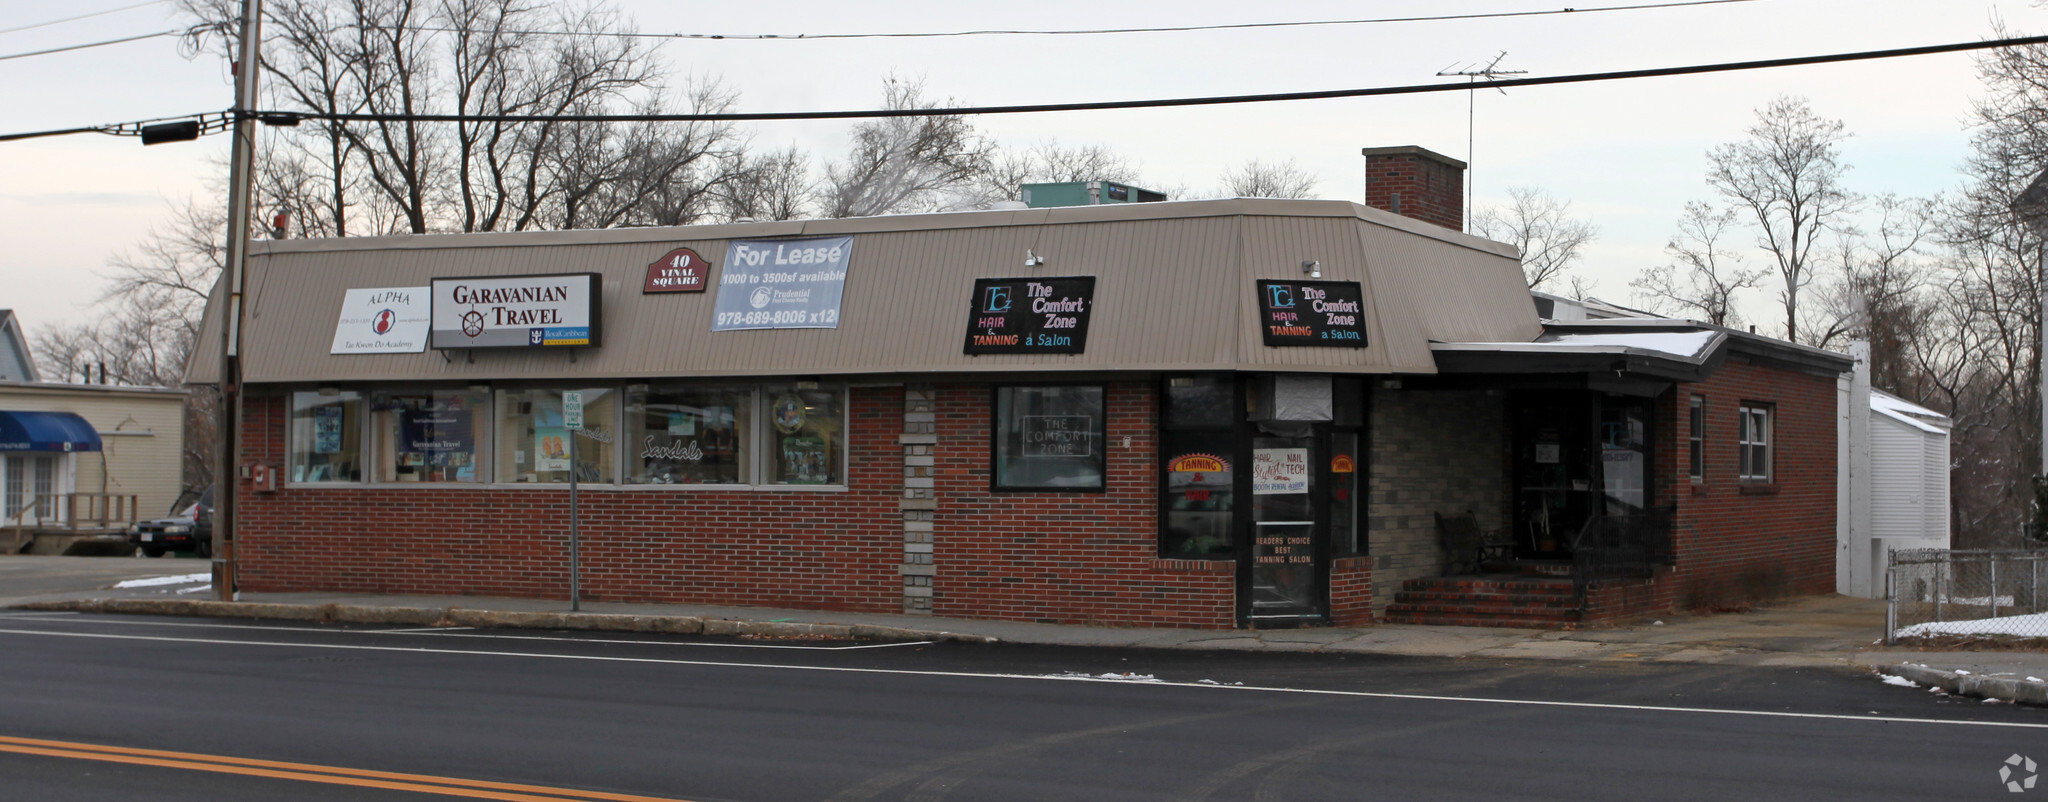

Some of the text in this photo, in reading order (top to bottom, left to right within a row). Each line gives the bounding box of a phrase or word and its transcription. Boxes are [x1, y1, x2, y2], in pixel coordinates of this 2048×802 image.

[670, 254, 690, 268] 40
[733, 244, 841, 266] For Lease
[661, 268, 695, 277] VINAL
[723, 270, 845, 284] 1000 to 3500sf available
[652, 277, 699, 287] SQUARE
[453, 285, 568, 304] GARAVANIAN
[773, 288, 811, 298] Prudential
[1027, 282, 1053, 298] The
[1302, 286, 1327, 300] The
[367, 291, 411, 306] ALPHA
[1032, 297, 1085, 314] Comfort
[1312, 299, 1359, 314] Comfort
[492, 306, 562, 325] TRAVEL
[717, 309, 836, 326] 978-689-8006 x12
[1043, 313, 1077, 329] Zone
[1272, 312, 1299, 321] HAIR
[1326, 312, 1356, 326] Zone
[978, 317, 1005, 328] HAIR
[1270, 326, 1313, 336] TANNING
[1321, 329, 1361, 340] a Salon
[355, 340, 374, 349] Kwon
[374, 340, 384, 348] Do
[384, 339, 413, 350] Academy
[973, 334, 1019, 346] TANNING
[1025, 333, 1072, 347] a Salon
[567, 394, 578, 402] ONE
[565, 403, 580, 411] HOUR
[1042, 418, 1068, 430] THE
[1026, 430, 1089, 443] COMFORT
[443, 440, 461, 449] Travel
[641, 435, 704, 460] Sandals
[1040, 443, 1074, 455] ZONE
[1253, 453, 1303, 463] HAIR NAIL
[1181, 459, 1216, 471] TANNING
[1254, 461, 1282, 483] Stylist
[1286, 464, 1305, 475] TECH
[1256, 537, 1311, 545] READERS CHOICE
[1274, 546, 1291, 554] BEST
[1255, 556, 1311, 564] TANNING SALON
